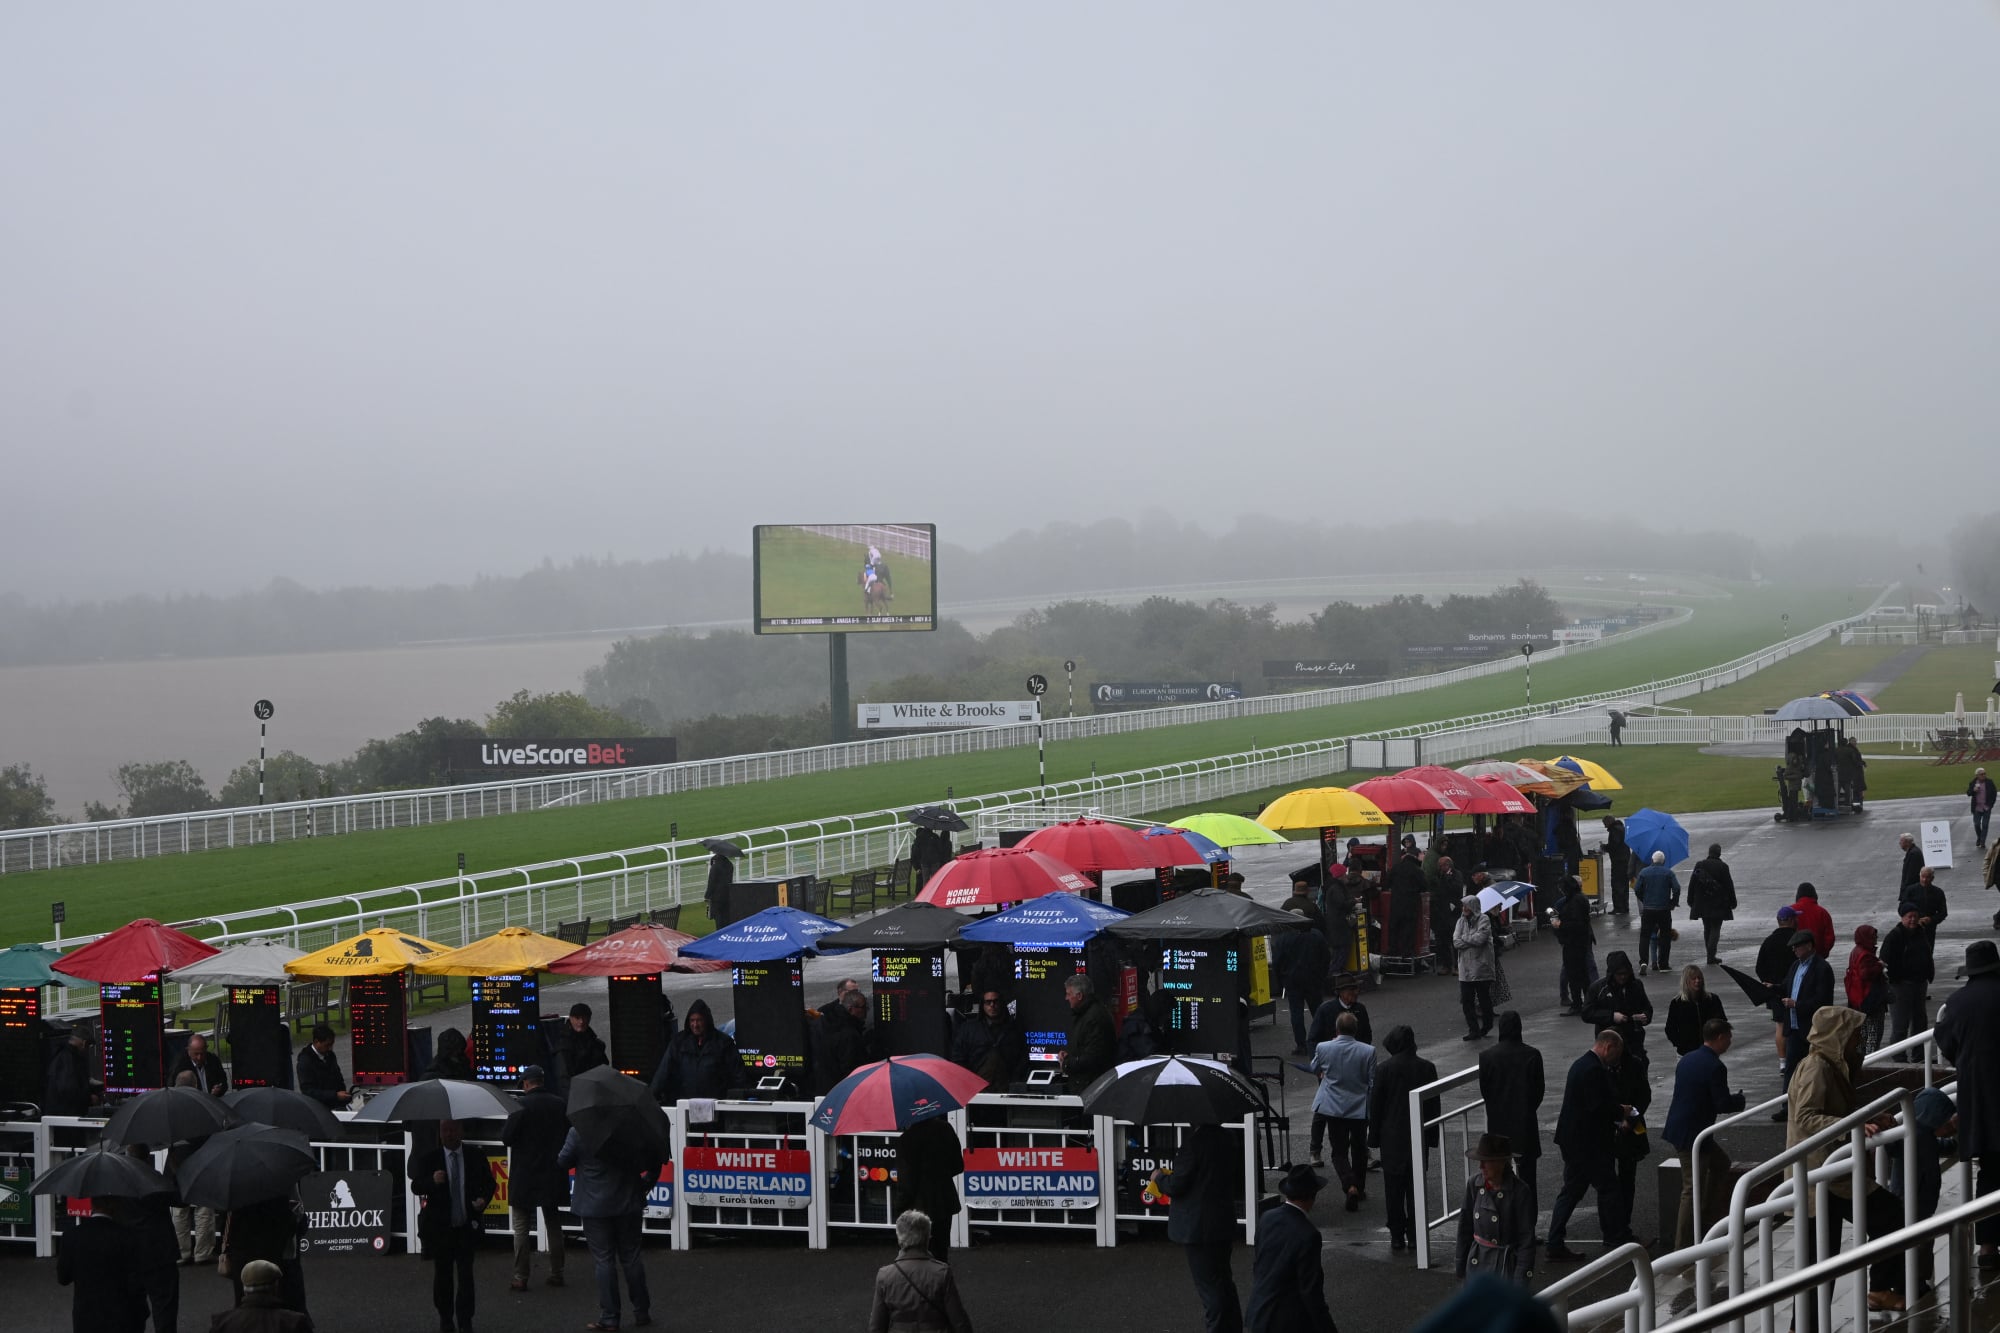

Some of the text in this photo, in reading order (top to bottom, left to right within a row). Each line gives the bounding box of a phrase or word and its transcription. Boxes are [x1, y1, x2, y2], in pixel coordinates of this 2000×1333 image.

[1524, 646, 1529, 654] 1
[1067, 662, 1071, 670] 1
[1296, 662, 1356, 674] Phase Eight
[893, 704, 936, 718] White
[940, 704, 952, 717] &
[956, 703, 1006, 716] Brooks
[947, 888, 980, 898] NORMAN
[945, 896, 976, 906] BARNES
[995, 916, 1078, 925] SUNDERLAND
[743, 925, 778, 934] White
[718, 934, 788, 944] Sunderland
[324, 956, 380, 966] SHERLOCK
[1210, 1070, 1259, 1106] Calvin Klein Golf
[857, 1149, 871, 1158] SID
[716, 1152, 776, 1169] WHITE
[997, 1151, 1064, 1167] WHITE
[1132, 1159, 1155, 1171] SID
[687, 1173, 806, 1192] SUNDERLAND
[968, 1176, 1095, 1192] SUNDERLAND
[719, 1195, 775, 1206] Euros taken
[1010, 1199, 1055, 1207] CARD PAYMENTS
[305, 1210, 384, 1229] HERLOCK
